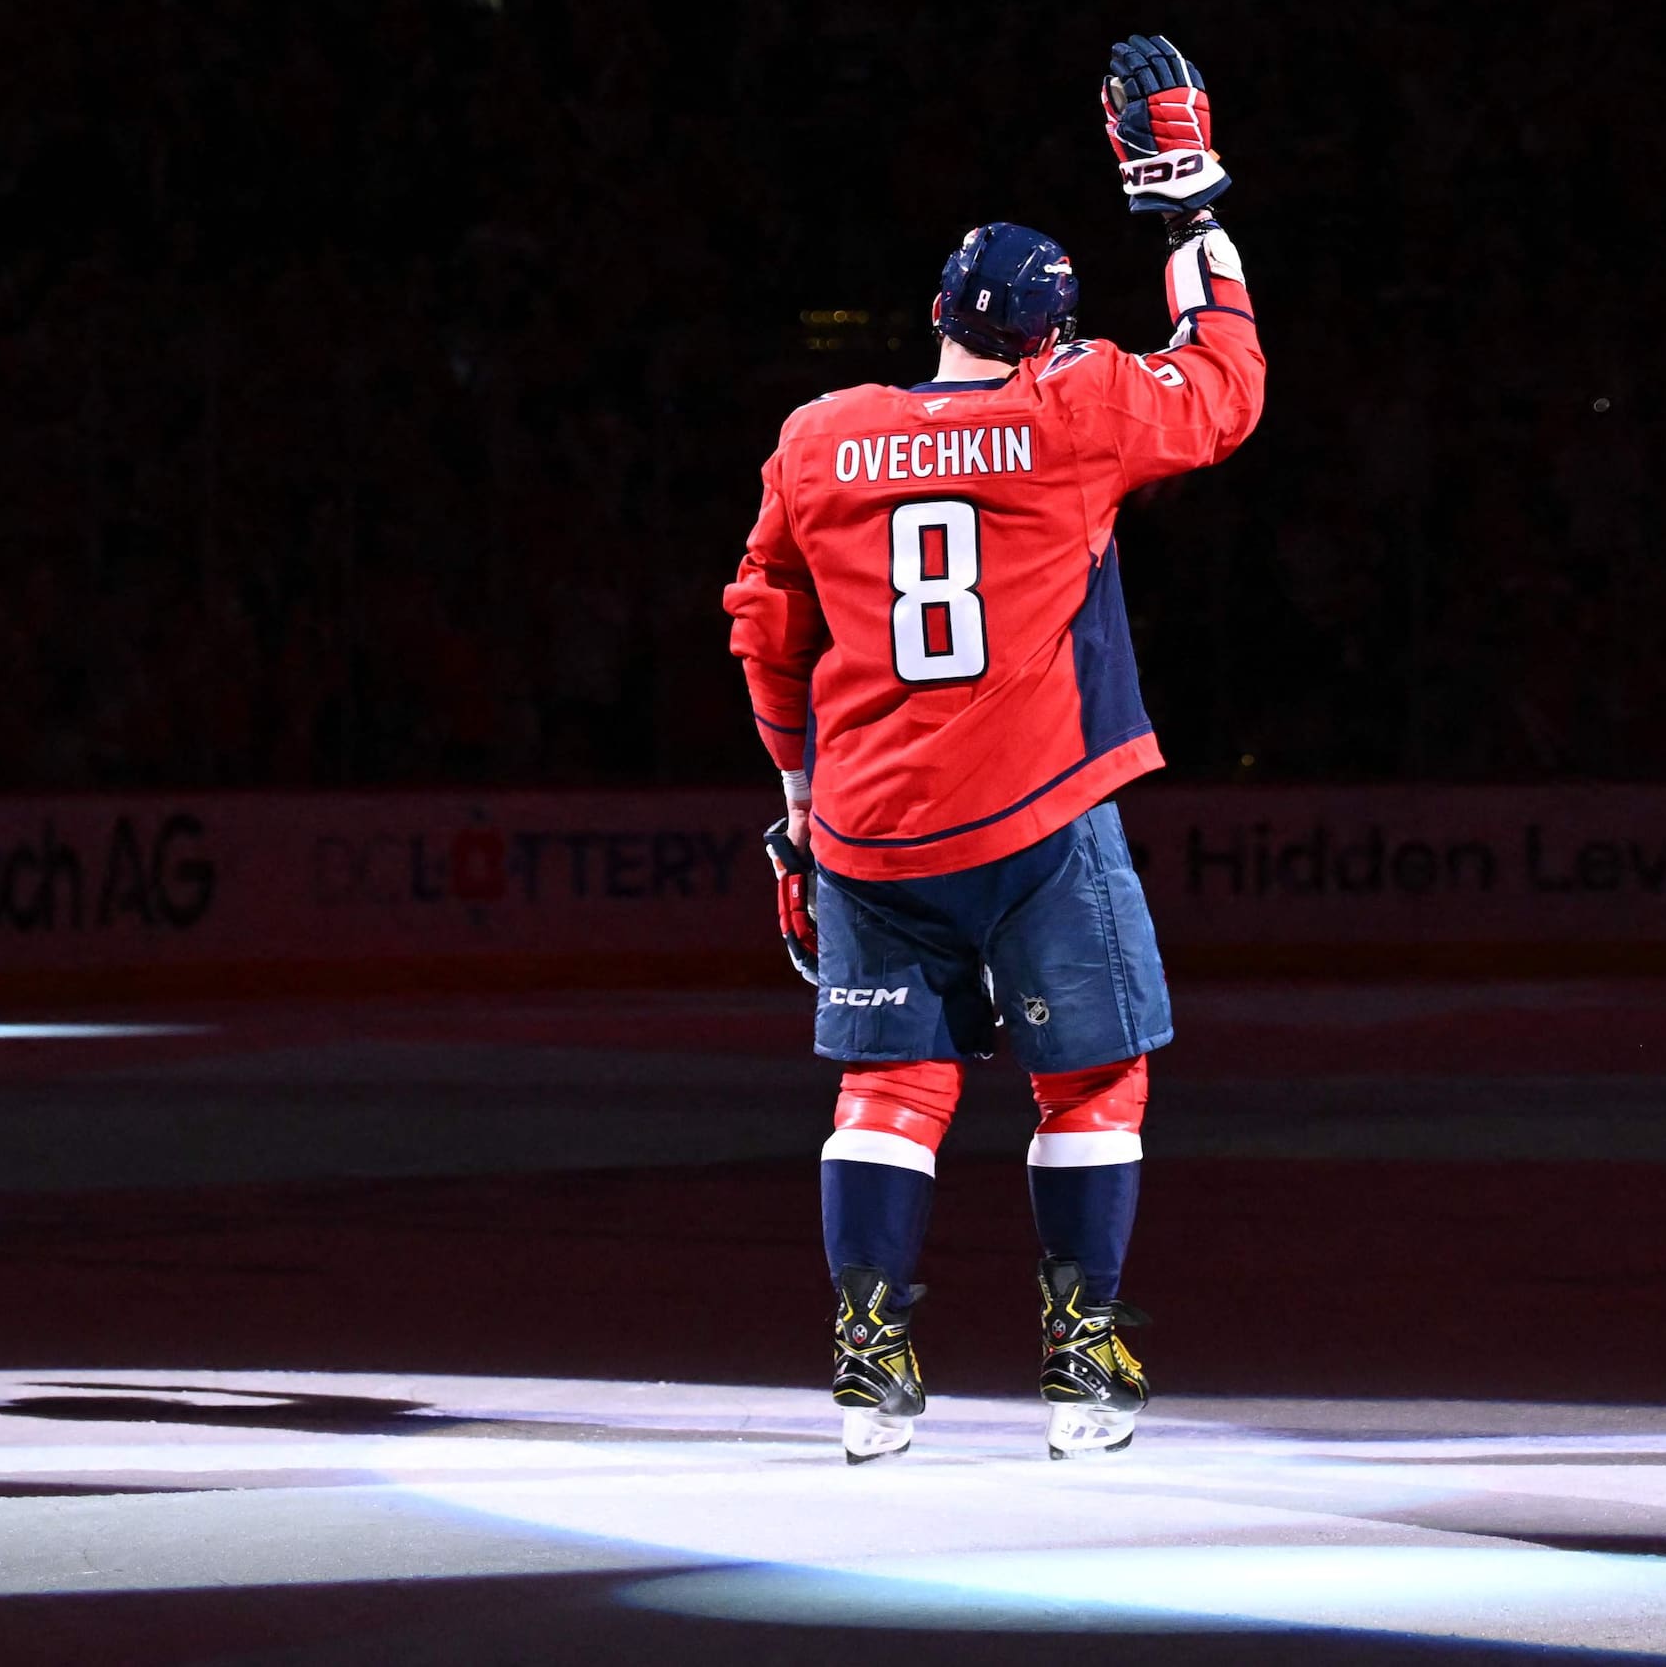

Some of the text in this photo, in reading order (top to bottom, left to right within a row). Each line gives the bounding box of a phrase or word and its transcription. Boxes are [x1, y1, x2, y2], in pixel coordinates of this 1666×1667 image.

[1121, 153, 1203, 187] CCM
[976, 289, 991, 312] 8
[835, 425, 1032, 483] OVECHKIN
[889, 496, 989, 685] 8
[98, 814, 215, 928] AG
[1187, 823, 1496, 893] Hidden
[829, 987, 909, 1007] CCM
